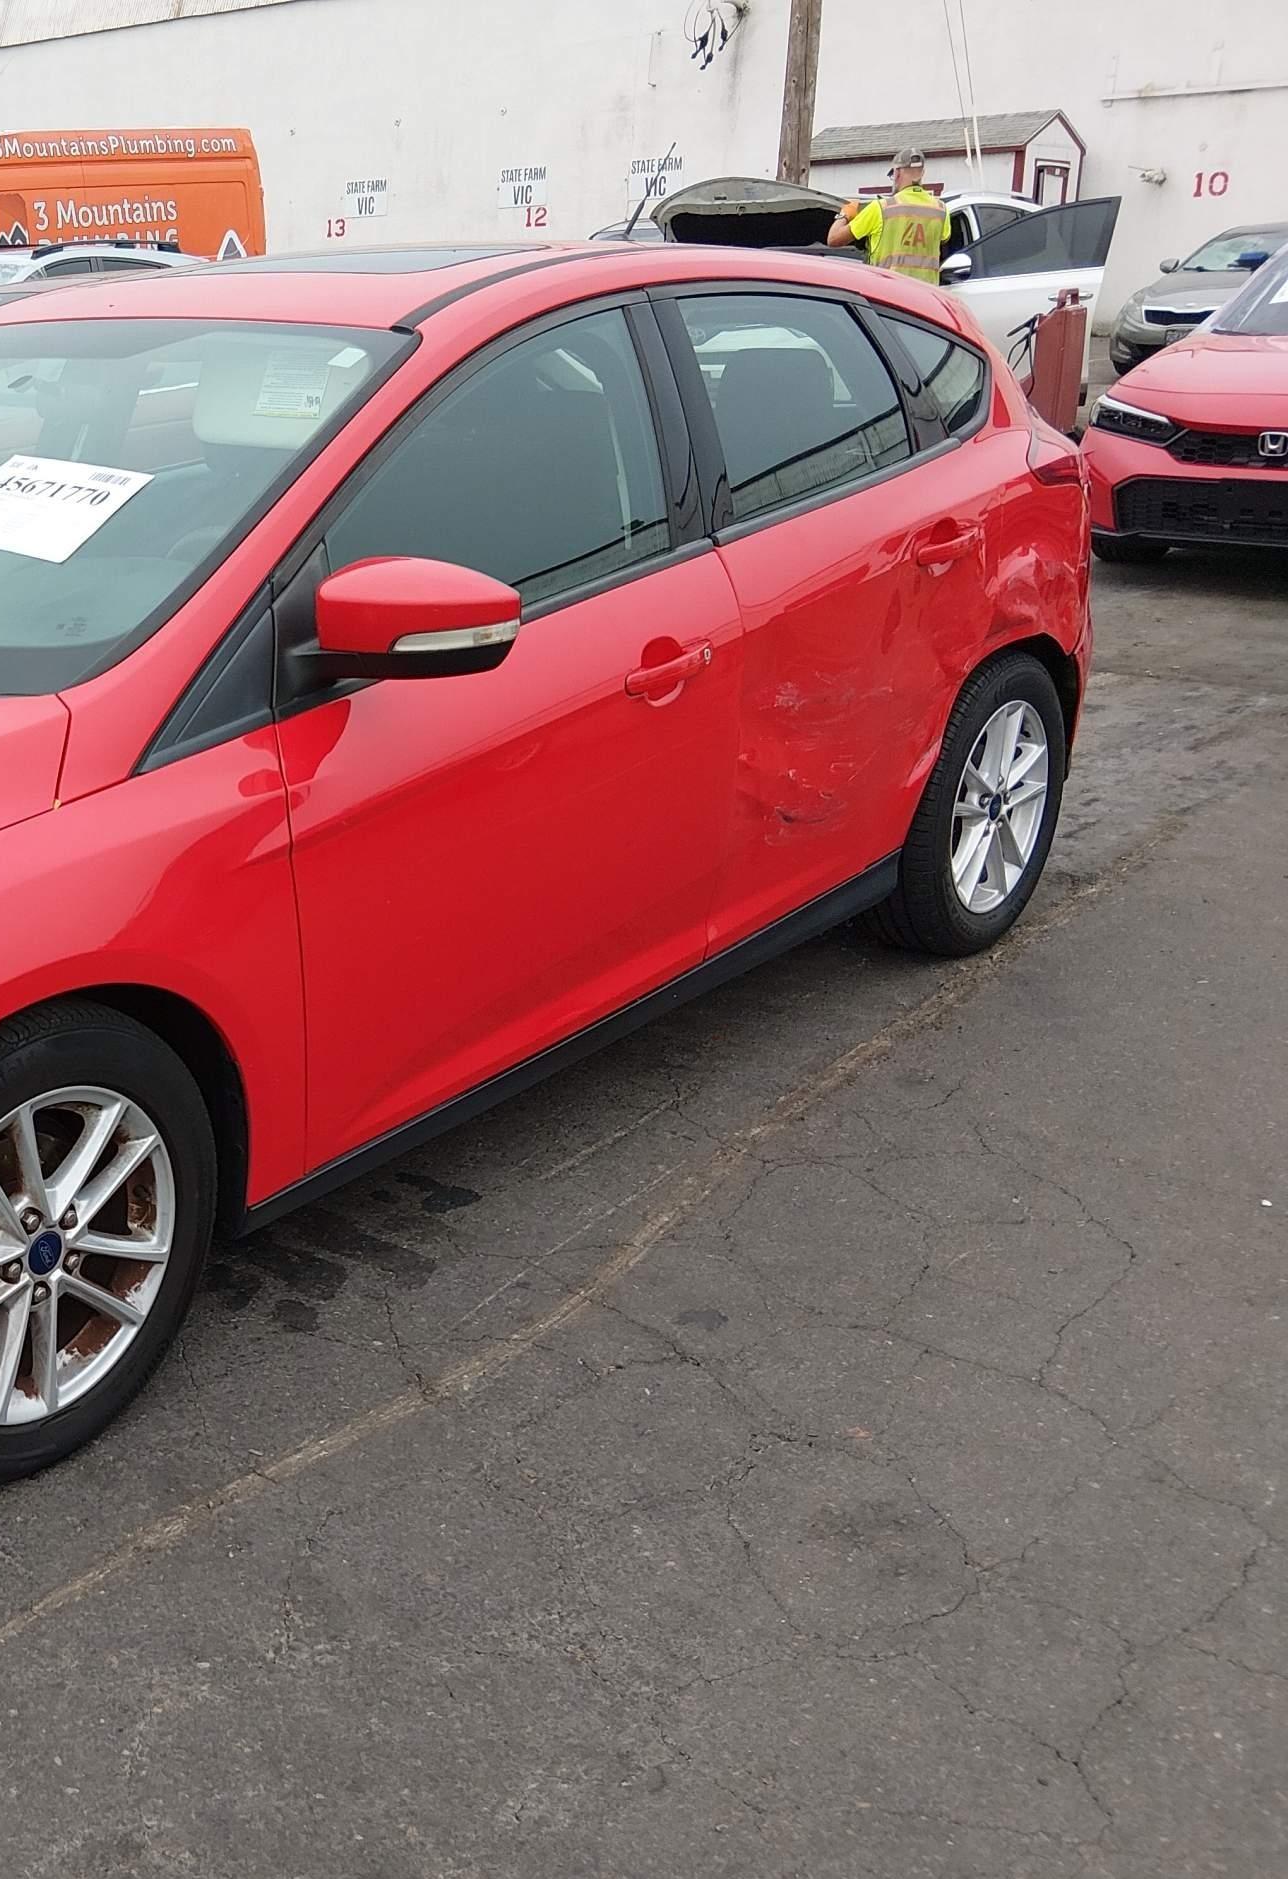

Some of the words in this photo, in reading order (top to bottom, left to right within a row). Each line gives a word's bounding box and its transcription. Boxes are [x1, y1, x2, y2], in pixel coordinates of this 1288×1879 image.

[501, 168, 523, 183] STATE
[524, 166, 547, 181] FARM
[631, 158, 656, 175] STATE
[657, 156, 682, 172] FARM
[346, 181, 365, 195] STATE
[367, 179, 387, 193] FARM
[645, 176, 666, 197] VIC
[1193, 171, 1229, 197] 10
[513, 185, 532, 205] VIC
[33, 201, 49, 230] 3
[56, 195, 178, 229] Mountains
[357, 196, 375, 215] VIC
[525, 206, 548, 228] 12
[327, 218, 346, 238] 13
